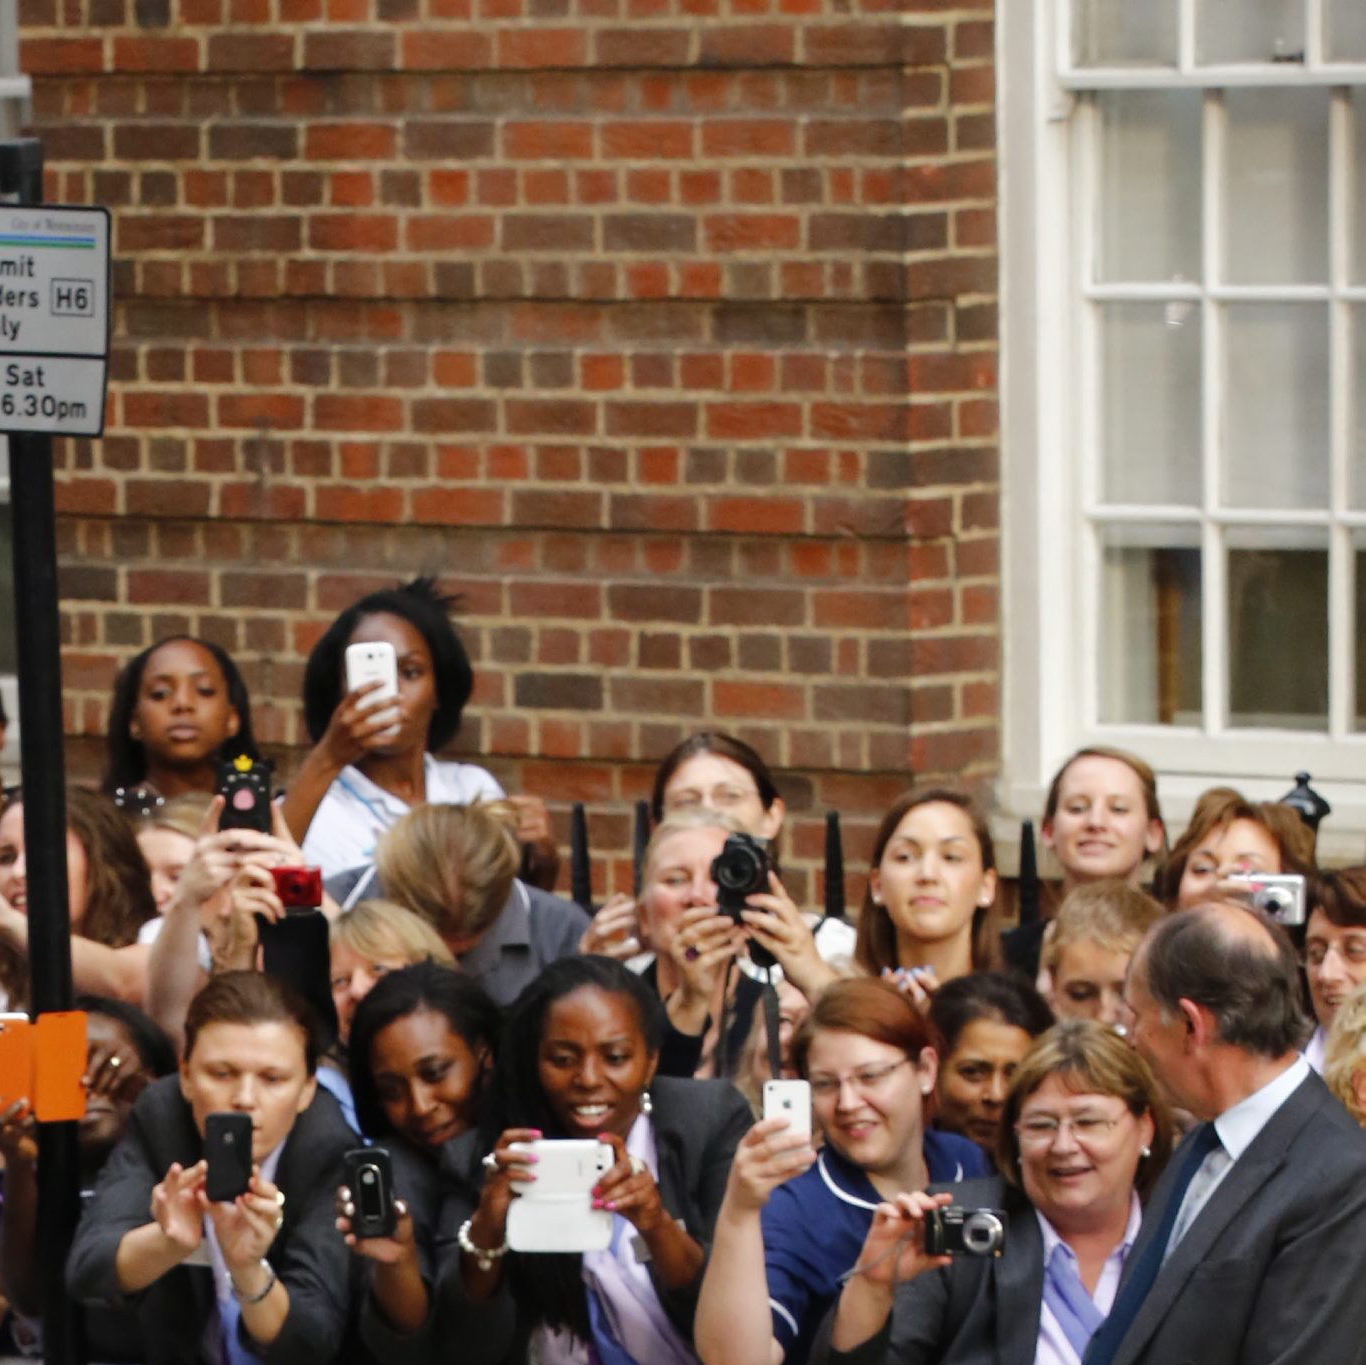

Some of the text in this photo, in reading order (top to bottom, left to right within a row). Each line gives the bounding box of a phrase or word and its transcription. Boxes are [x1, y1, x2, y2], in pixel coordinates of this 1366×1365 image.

[56, 288, 89, 310] H6
[6, 364, 45, 388] Sat
[1, 393, 87, 421] 6.30pm
